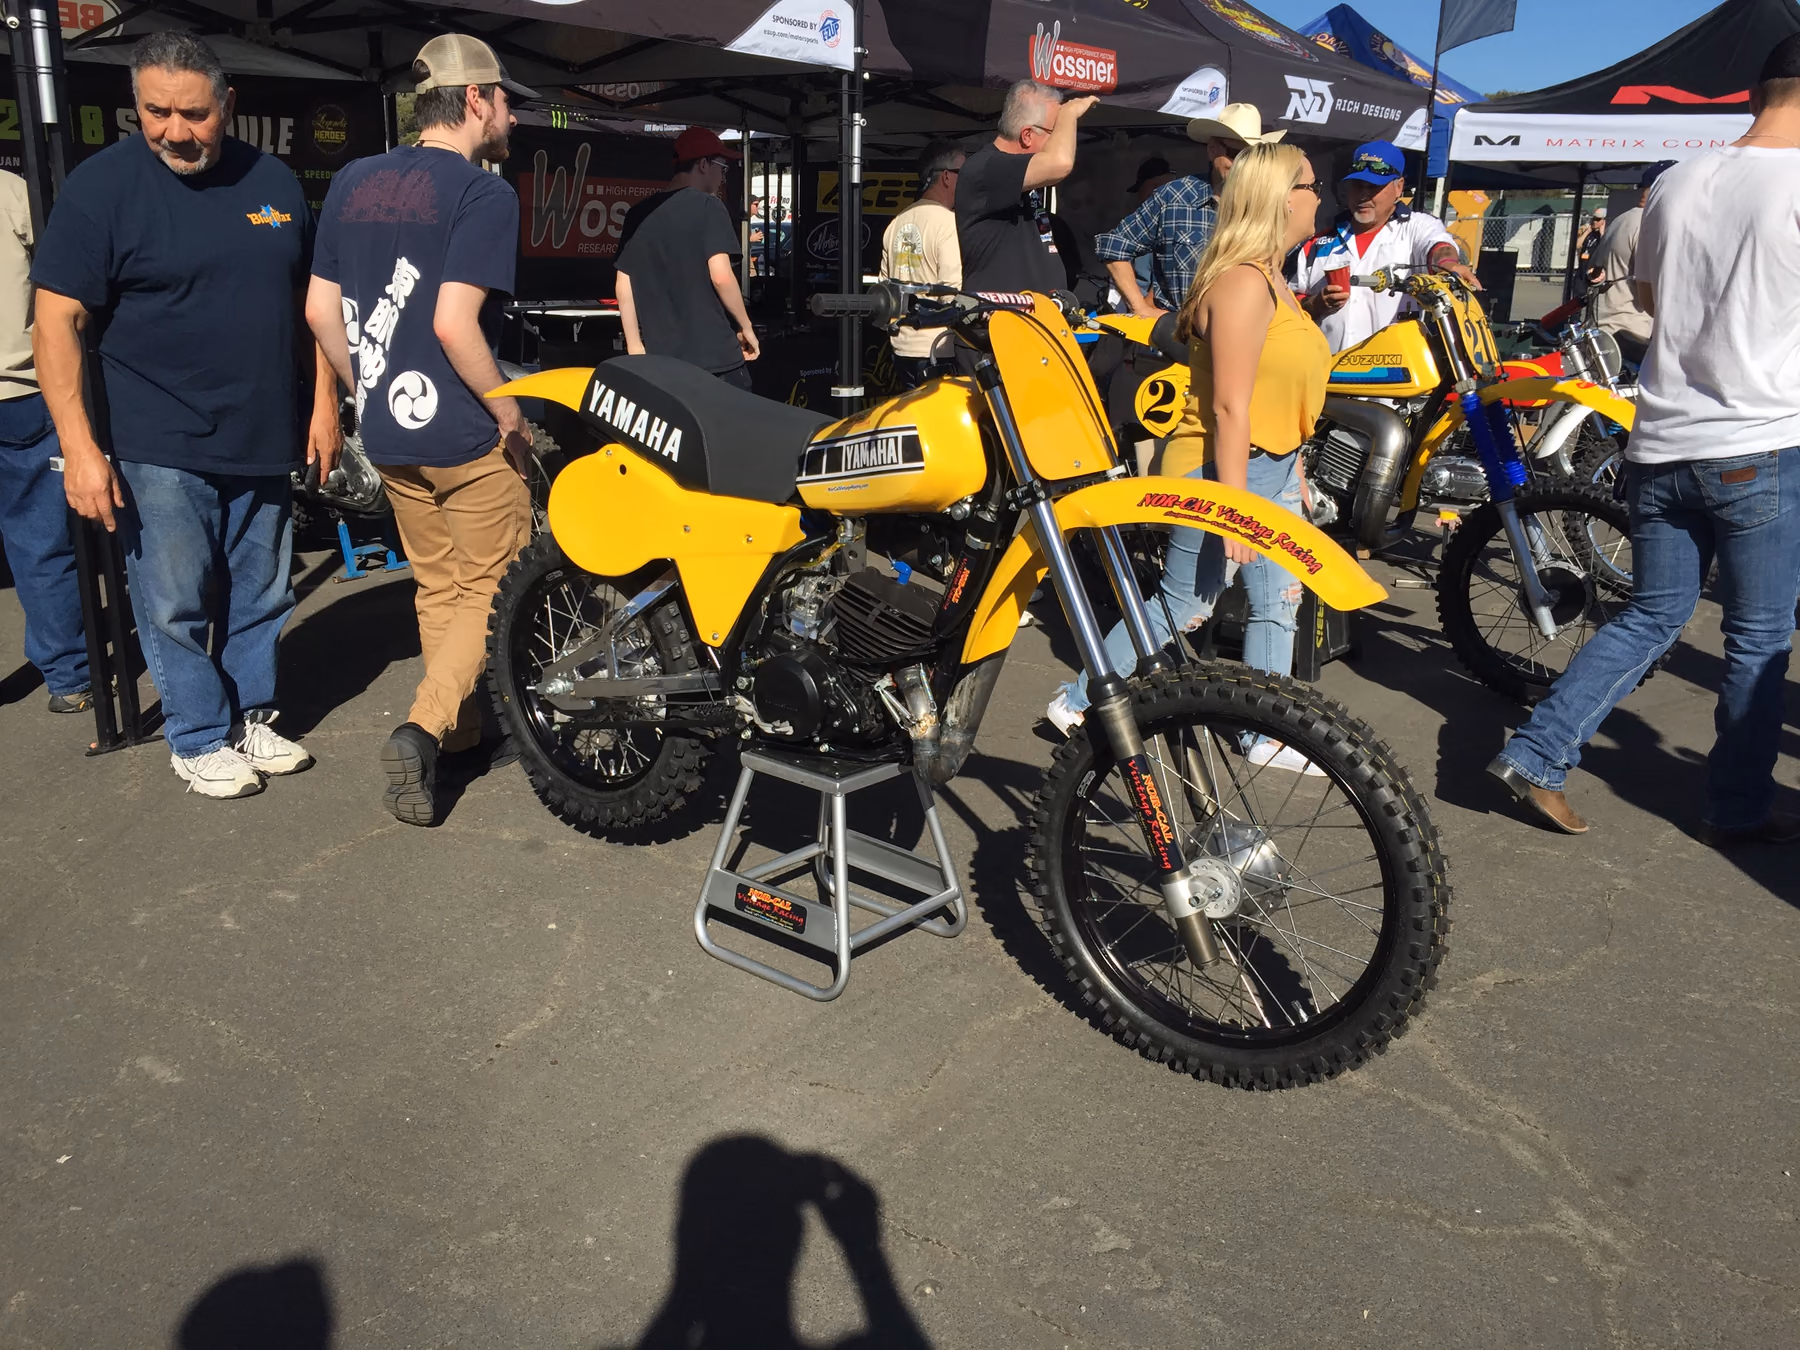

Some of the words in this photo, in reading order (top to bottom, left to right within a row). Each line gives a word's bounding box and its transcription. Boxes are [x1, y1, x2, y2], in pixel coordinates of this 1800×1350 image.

[772, 14, 809, 29] SPONSORED
[809, 22, 818, 31] BY
[1335, 98, 1360, 113] RICH
[1362, 103, 1402, 122] DESIGNS
[314, 130, 346, 141] HEROES
[1546, 138, 1645, 148] MATRIX
[605, 186, 627, 196] HIGH
[1338, 354, 1402, 366] SUZUKI
[799, 368, 824, 378] Sponsored
[1142, 379, 1177, 423] 2
[588, 379, 683, 463] YAMAHA
[846, 437, 898, 470] YAMAHA
[1137, 493, 1217, 515] NOR-CAL
[1216, 504, 1275, 539] Vintage
[1271, 532, 1323, 575] Racing
[1127, 759, 1152, 817] Vintage
[1147, 819, 1173, 871] Racing
[1141, 774, 1174, 844] NOR-CAL
[748, 887, 792, 911] NOR-CAL
[773, 904, 804, 927] Racing
